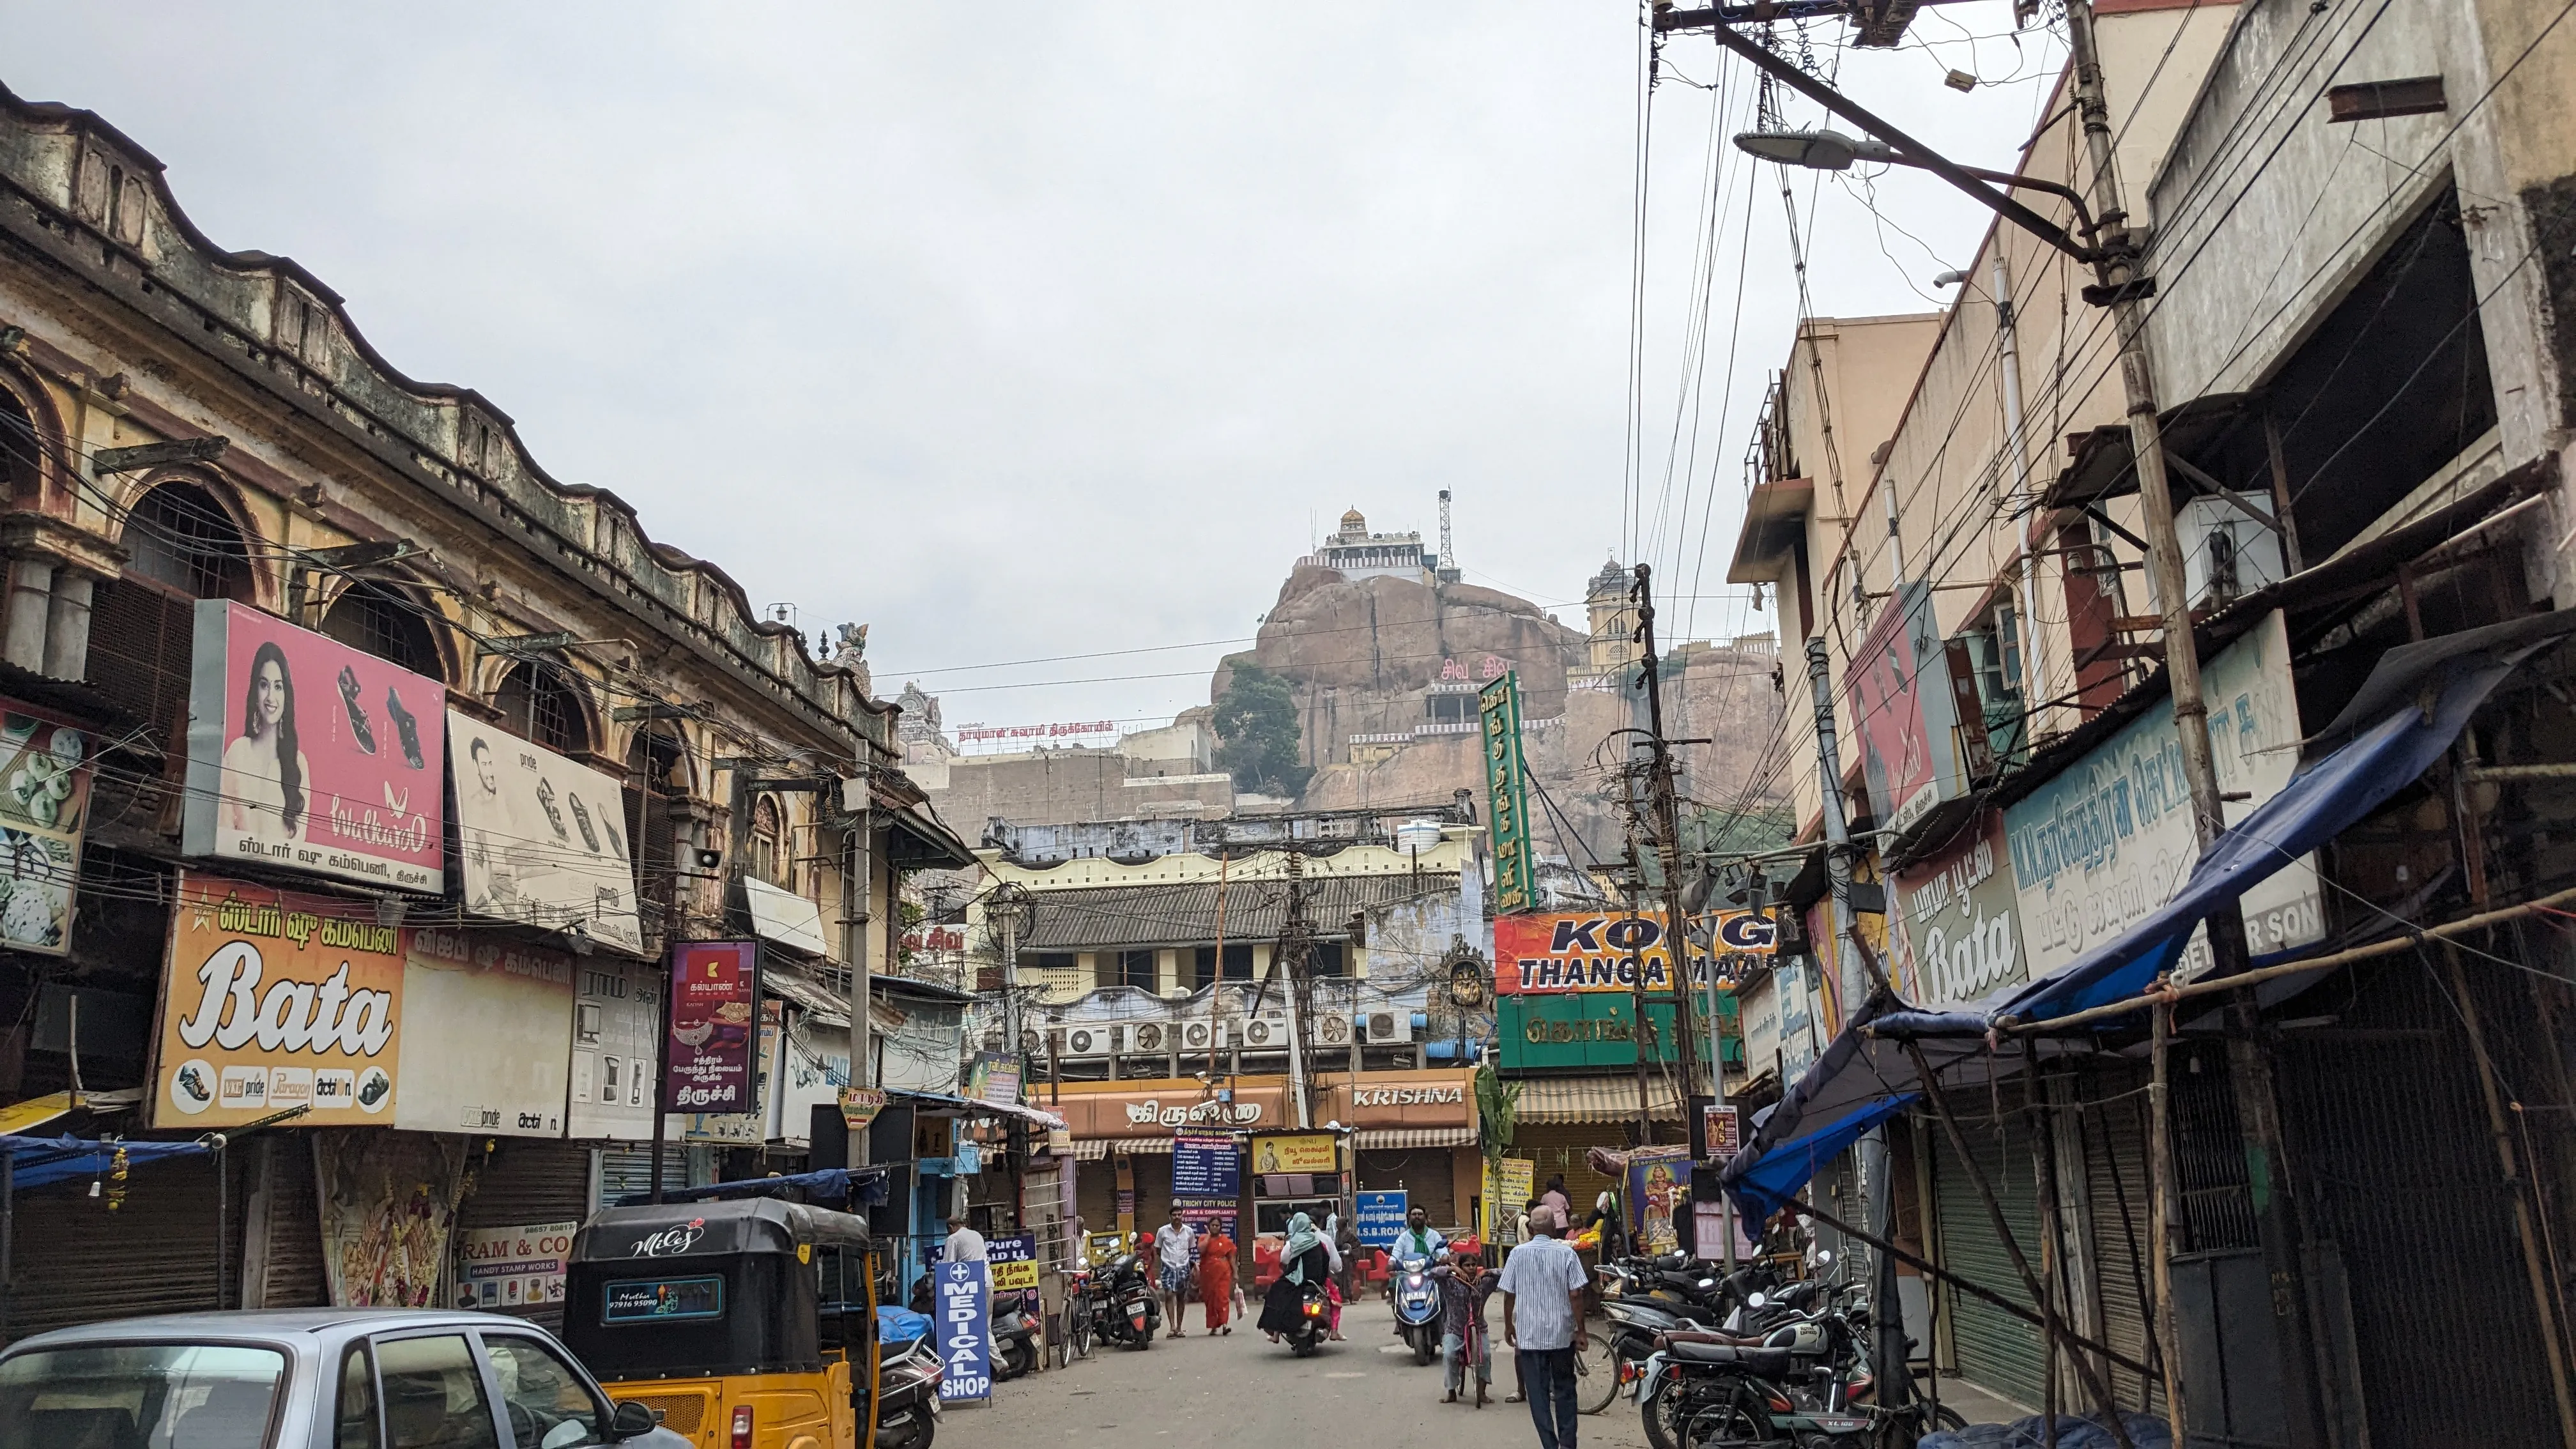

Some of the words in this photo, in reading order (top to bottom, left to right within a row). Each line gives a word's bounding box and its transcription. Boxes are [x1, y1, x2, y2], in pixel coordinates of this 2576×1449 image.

[1441, 659, 1469, 680] சிவ
[519, 753, 537, 770] pride
[240, 837, 291, 859] ஸ்டார்
[328, 854, 390, 879] கம்பெனி,
[396, 870, 427, 885] திருச்சி
[1925, 901, 2017, 1005] Bata
[690, 980, 734, 992] கல்யாண்
[179, 939, 394, 1057] Bata
[693, 1055, 723, 1066] சத்திரம்
[673, 1064, 707, 1075] பேருந்து
[708, 1064, 743, 1073] நிலையம்
[692, 1073, 723, 1083] அருகில்
[245, 1074, 265, 1097] pride
[676, 1084, 737, 1106] திருச்சி
[1353, 1087, 1463, 1107] KRISHNA
[1719, 1132, 1725, 1143] 5
[525, 1225, 548, 1234] 98657
[460, 1240, 510, 1261] RAM
[516, 1239, 532, 1256] &
[539, 1236, 569, 1254] CO
[986, 1239, 1022, 1251] Pure
[472, 1266, 499, 1276] HANDY
[501, 1264, 526, 1273] STAMP
[528, 1261, 556, 1271] WORKS
[609, 1300, 632, 1308] 97916
[633, 1299, 658, 1307] 95090
[620, 1292, 650, 1301] Muthu
[944, 1280, 980, 1377] MEDICAL
[941, 1376, 990, 1397] SHOP
